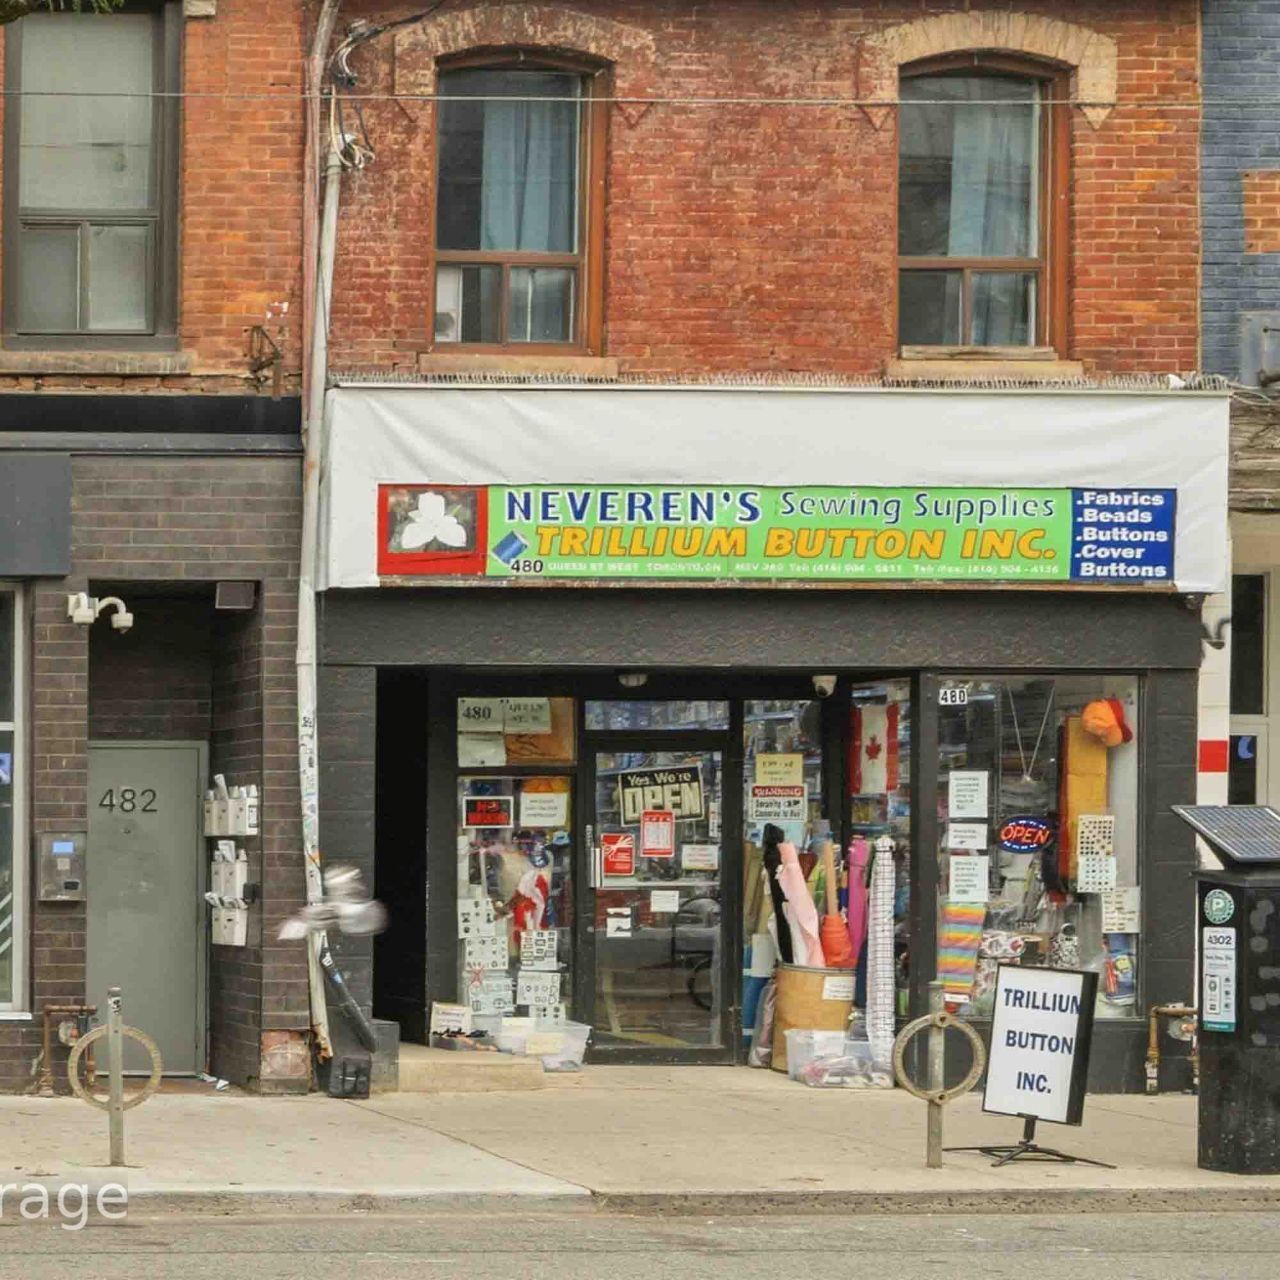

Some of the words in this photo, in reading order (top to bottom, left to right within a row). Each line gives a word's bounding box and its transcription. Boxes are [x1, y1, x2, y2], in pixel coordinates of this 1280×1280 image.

[505, 490, 762, 522] NEVEREN'S
[779, 491, 901, 525] Sewing
[913, 492, 1057, 527] Supplies
[536, 526, 748, 557] TRILLIUM
[763, 527, 947, 559] BUTTON
[960, 529, 1057, 560] INC.
[510, 558, 543, 573] 480
[1080, 561, 1168, 577] Buttons
[939, 689, 966, 704] 480
[462, 706, 492, 721] 480
[98, 788, 158, 813] 482
[623, 781, 701, 822] OPEN
[1000, 825, 1050, 846] OPEN
[1207, 935, 1232, 945] 4302
[1005, 1029, 1074, 1056] BUTTON
[1016, 1071, 1052, 1094] INC.
